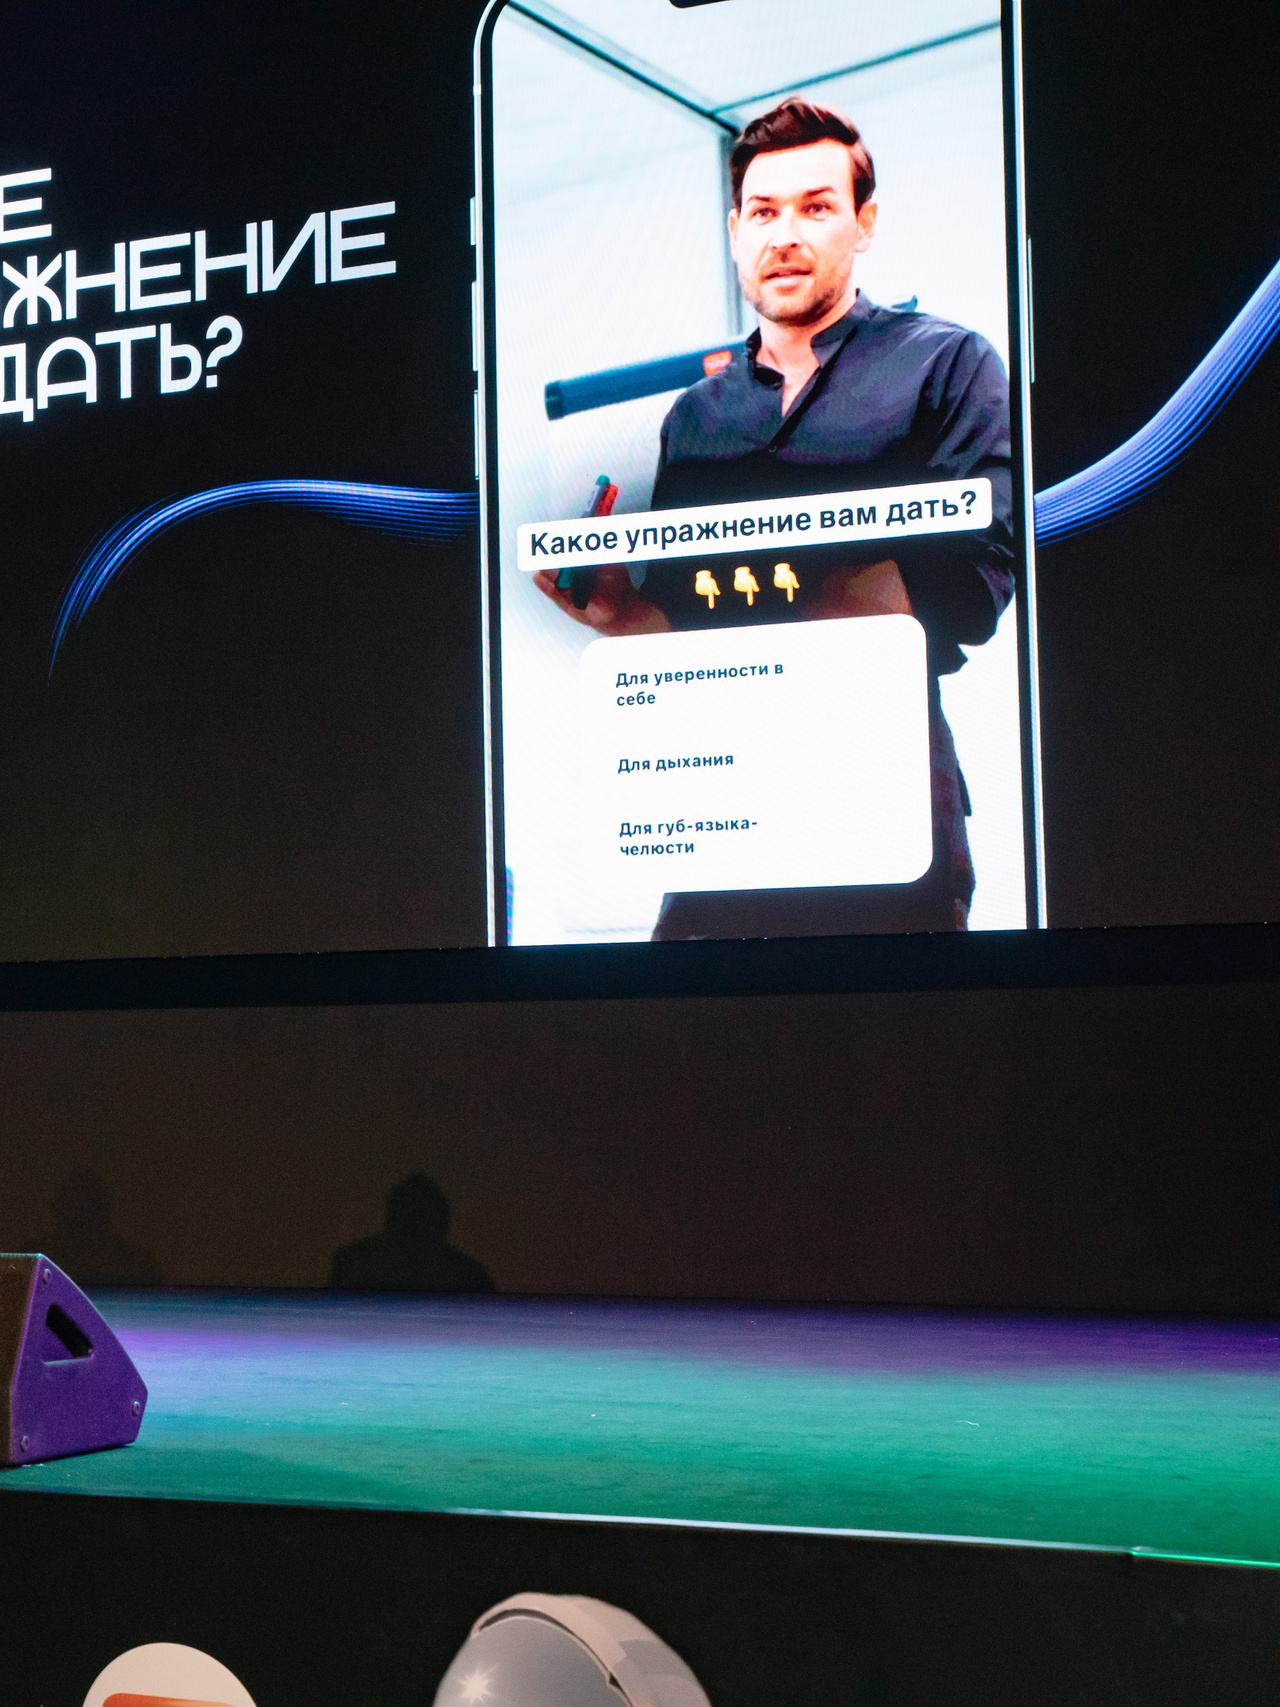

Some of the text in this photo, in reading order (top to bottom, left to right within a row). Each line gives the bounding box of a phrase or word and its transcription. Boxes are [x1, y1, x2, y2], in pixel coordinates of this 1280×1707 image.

[531, 490, 977, 556] Какое упражнение вам дать?
[616, 664, 783, 688] Для уверенности в
[616, 691, 656, 706] себе
[618, 755, 734, 774] Для дыхания
[619, 819, 758, 838] Для губ-языка-
[620, 843, 694, 856] челюсти
